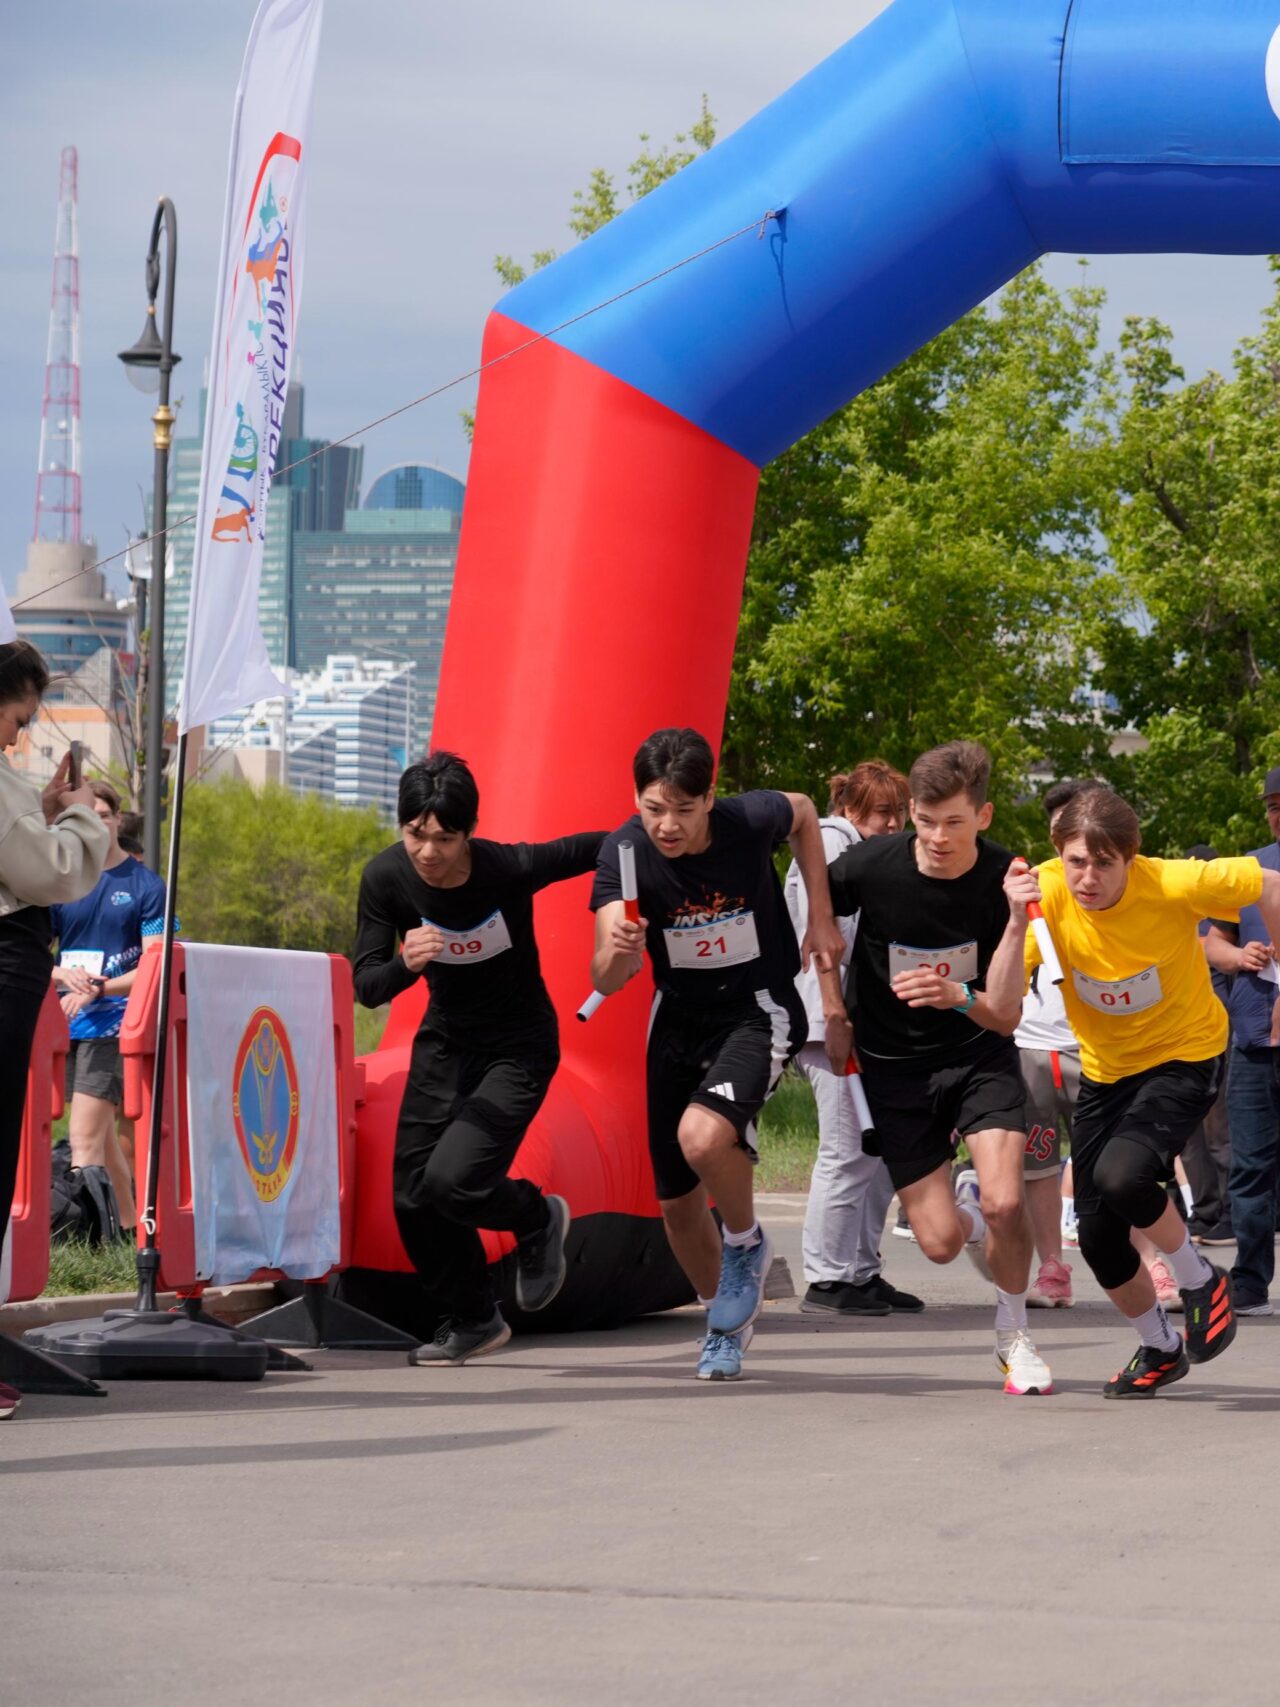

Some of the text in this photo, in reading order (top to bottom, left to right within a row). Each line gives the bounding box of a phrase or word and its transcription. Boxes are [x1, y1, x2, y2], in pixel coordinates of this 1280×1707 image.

[449, 940, 482, 956] 09
[695, 936, 726, 957] 21
[1100, 991, 1131, 1006] 01
